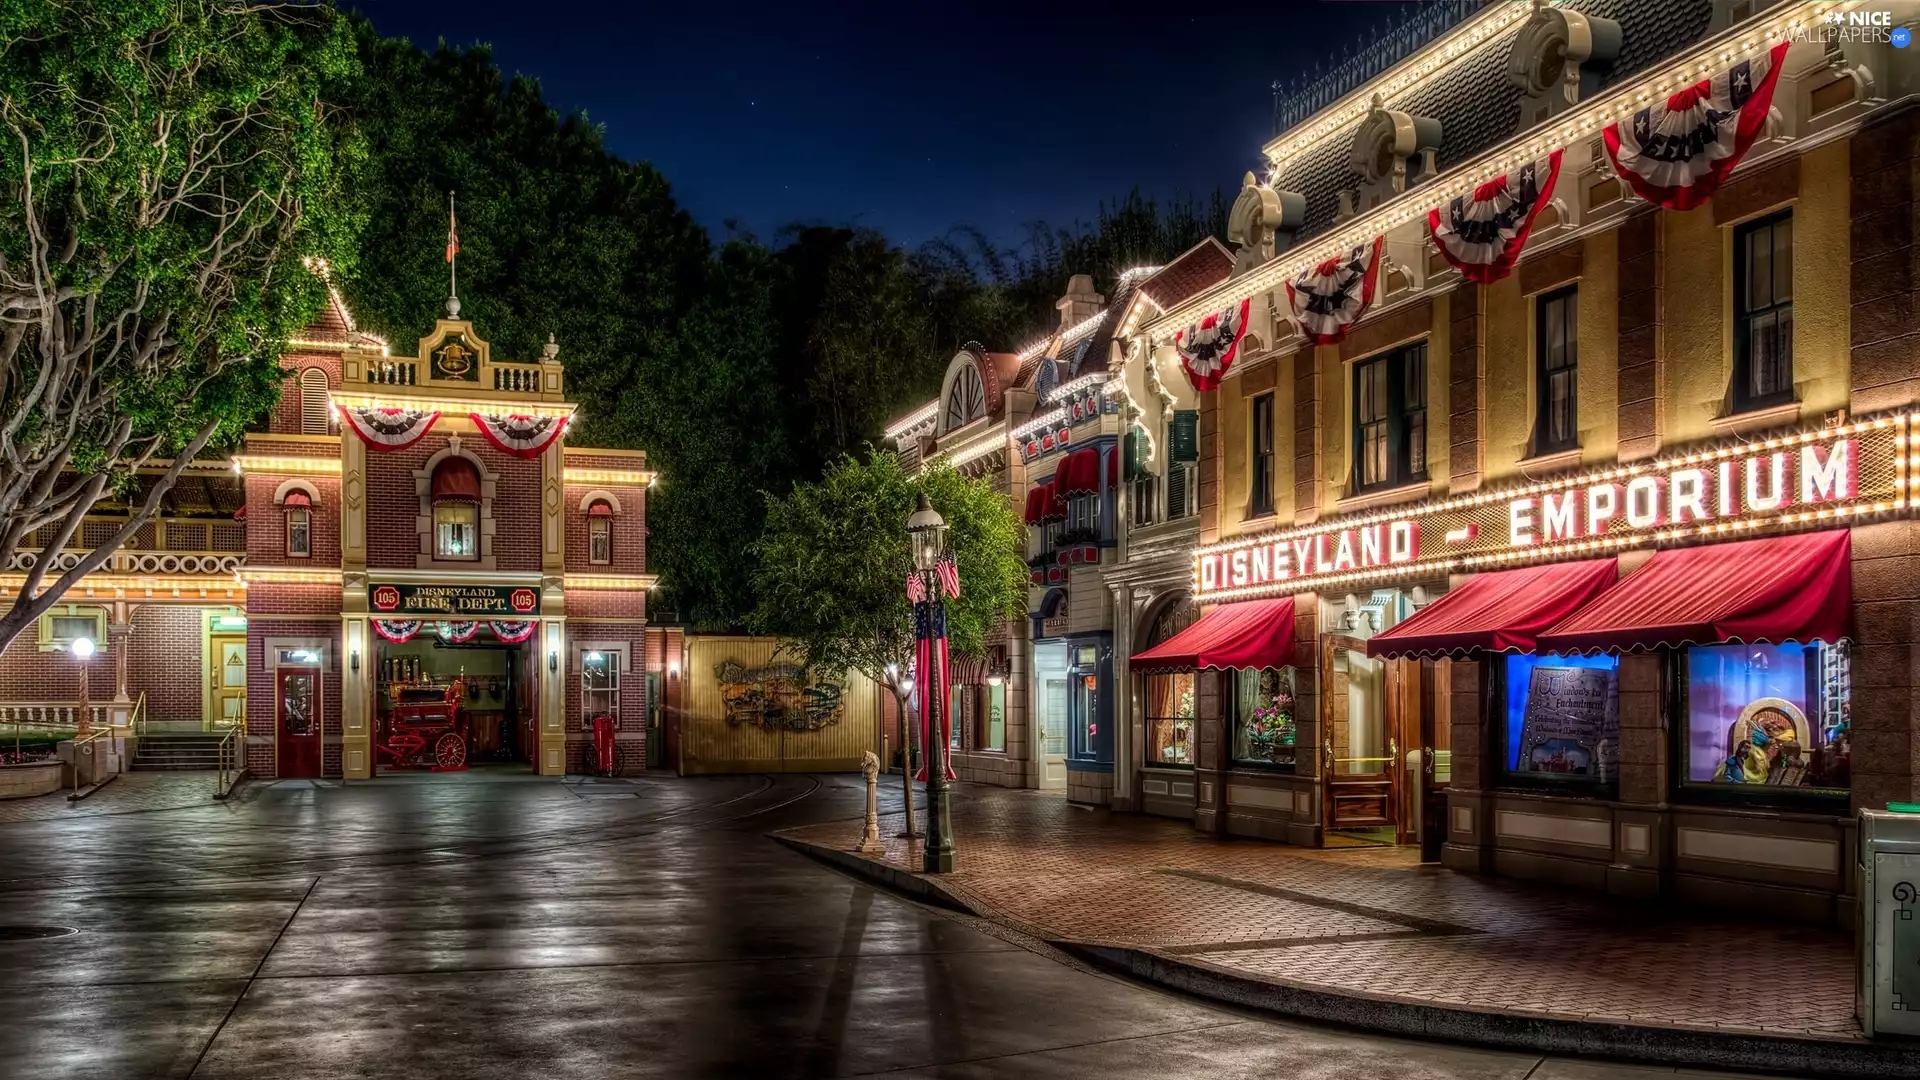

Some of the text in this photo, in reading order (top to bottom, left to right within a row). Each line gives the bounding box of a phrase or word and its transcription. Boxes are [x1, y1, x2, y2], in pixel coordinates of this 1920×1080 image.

[1201, 520, 1417, 590] DISNEYLAND
[1509, 440, 1858, 546] EMPORIUM
[377, 592, 396, 604] 105
[416, 588, 495, 597] DISNEYLAND
[404, 597, 507, 610] FIRE DEPT.
[515, 596, 531, 607] 105
